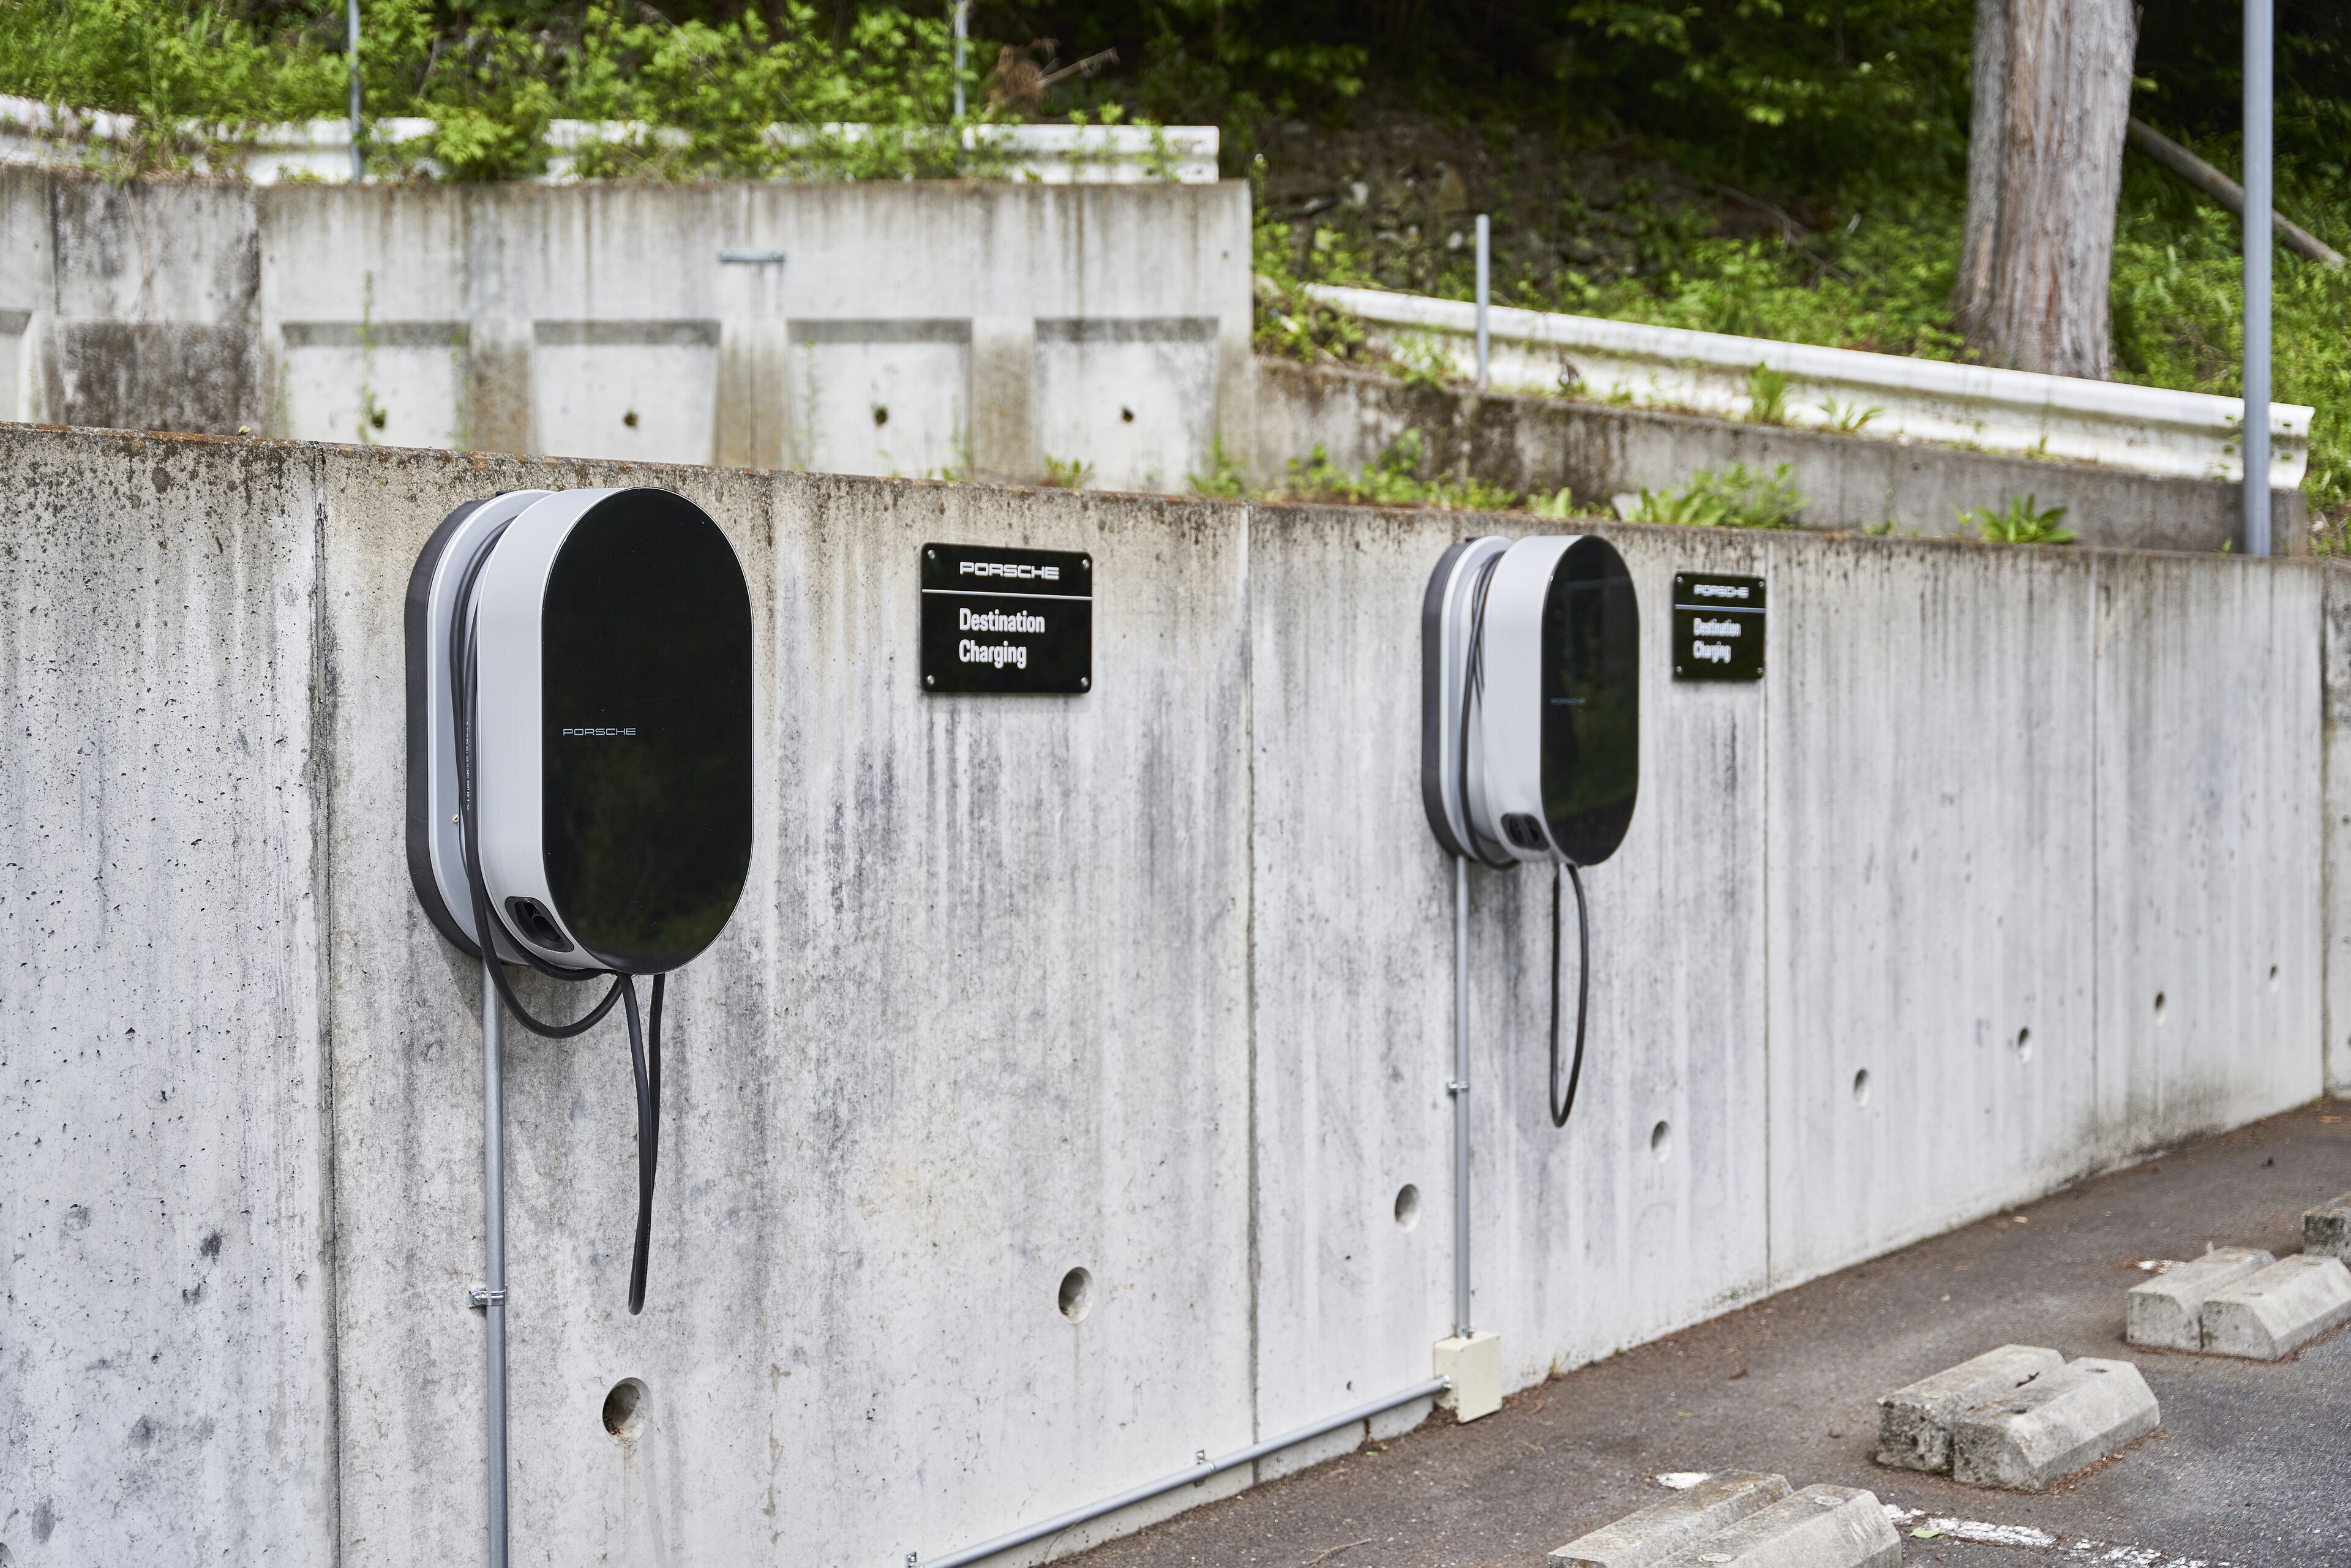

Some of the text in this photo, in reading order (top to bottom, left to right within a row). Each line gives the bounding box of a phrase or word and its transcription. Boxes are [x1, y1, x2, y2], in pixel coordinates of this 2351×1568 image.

[959, 561, 1060, 580] PORSCHE
[959, 607, 1045, 633] Destination
[959, 639, 1027, 669] Charging
[563, 727, 636, 736] PORSCHE
